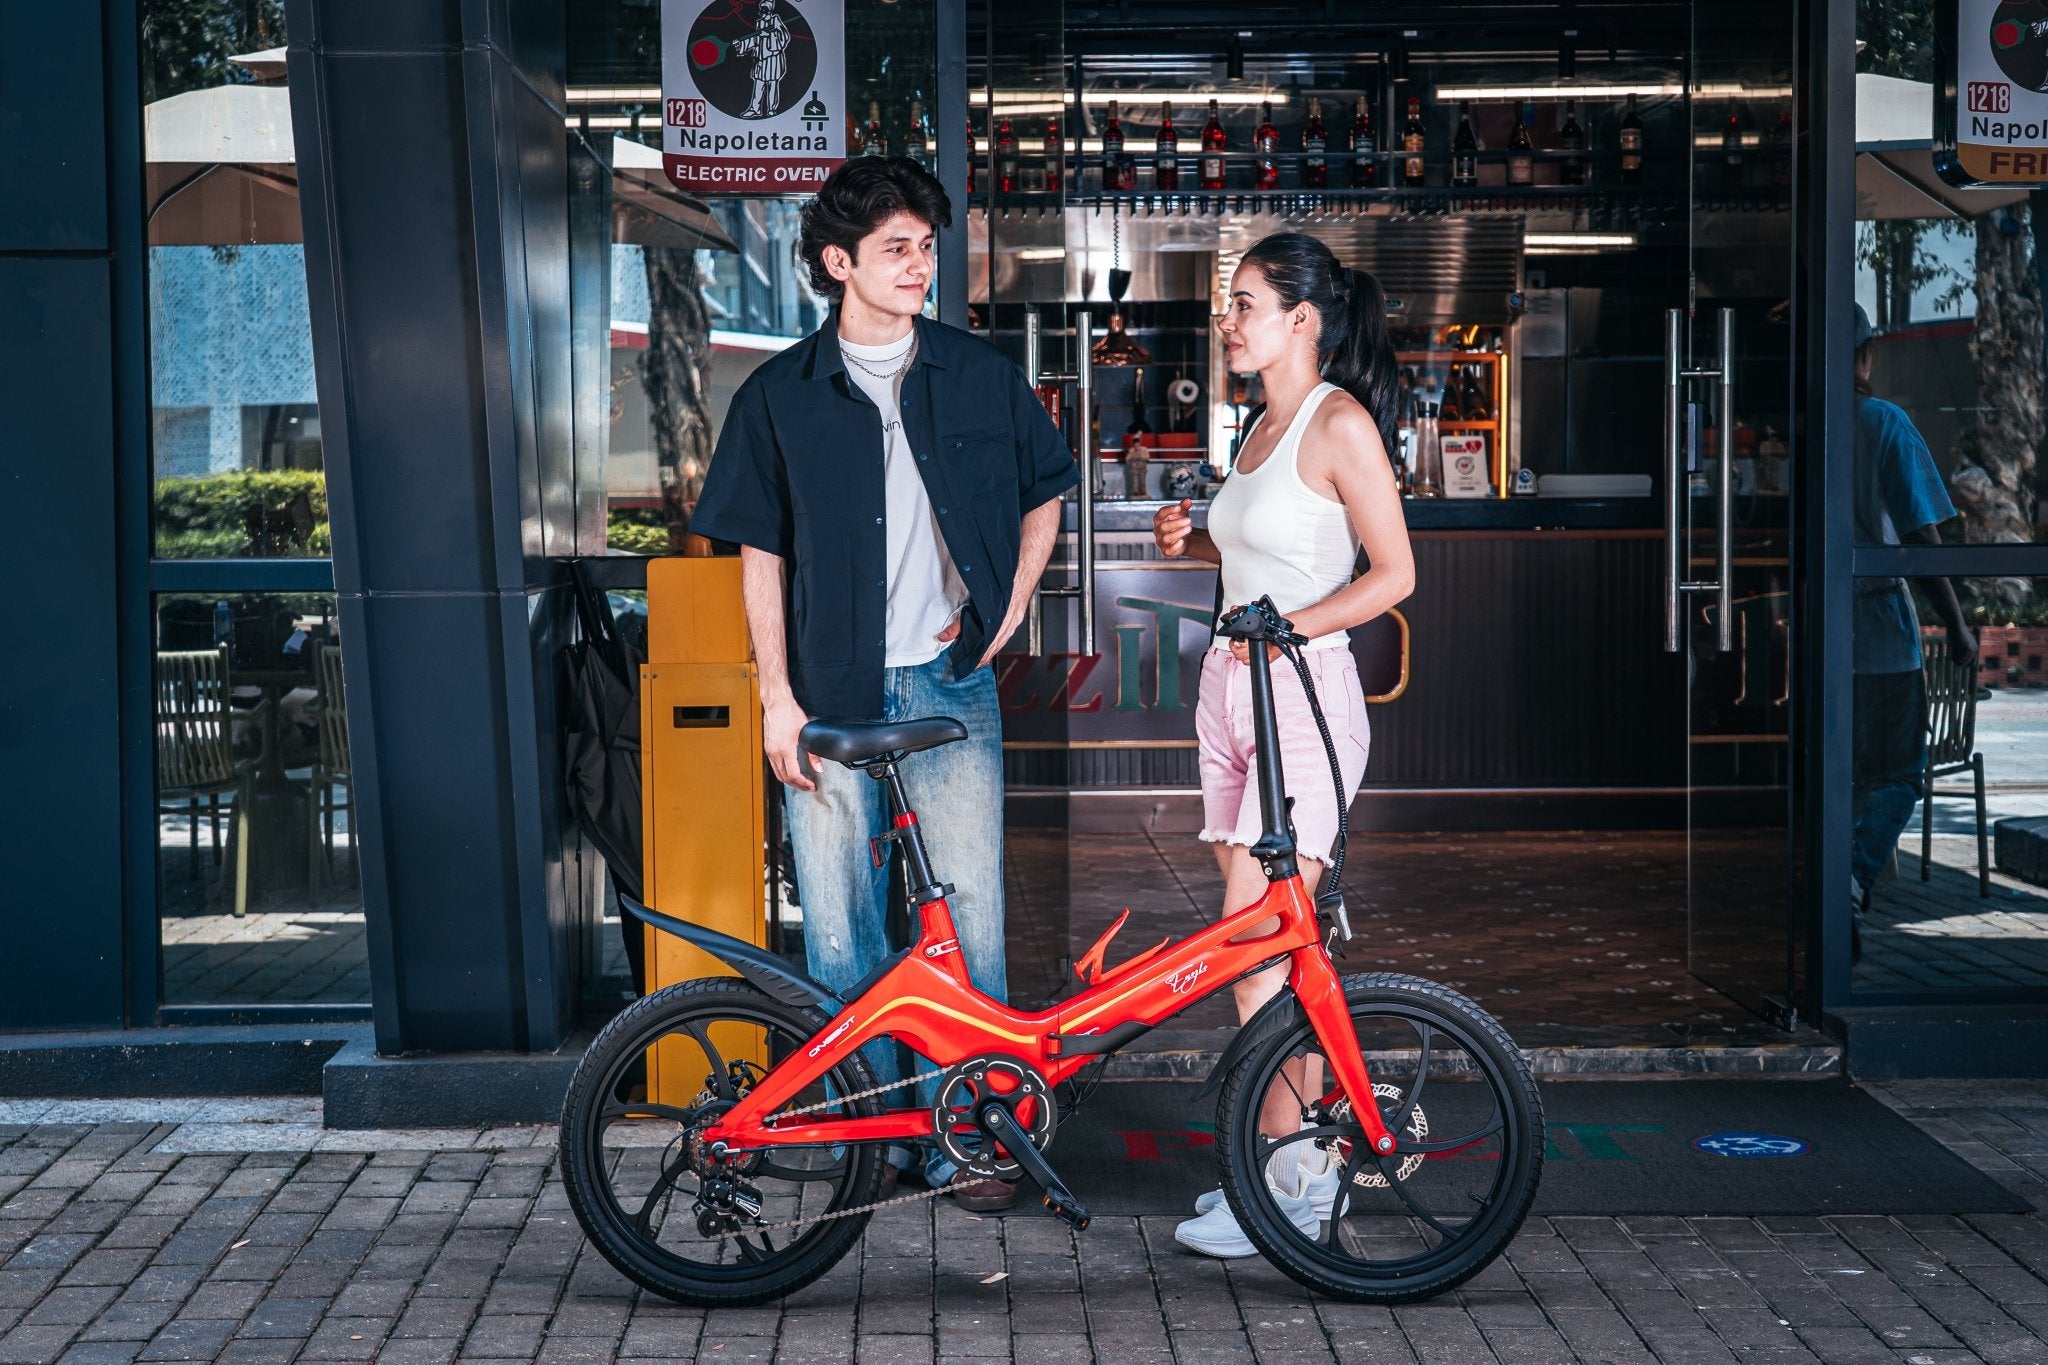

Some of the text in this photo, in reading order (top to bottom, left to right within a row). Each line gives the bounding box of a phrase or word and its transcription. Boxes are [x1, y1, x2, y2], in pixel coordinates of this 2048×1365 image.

[1968, 84, 2010, 112] 1218
[667, 101, 706, 127] 1218
[680, 129, 828, 154] Napoletana
[1972, 116, 2048, 144] Napol
[676, 164, 831, 182] ELECTRIC OVEN
[1990, 152, 2048, 175] FRI
